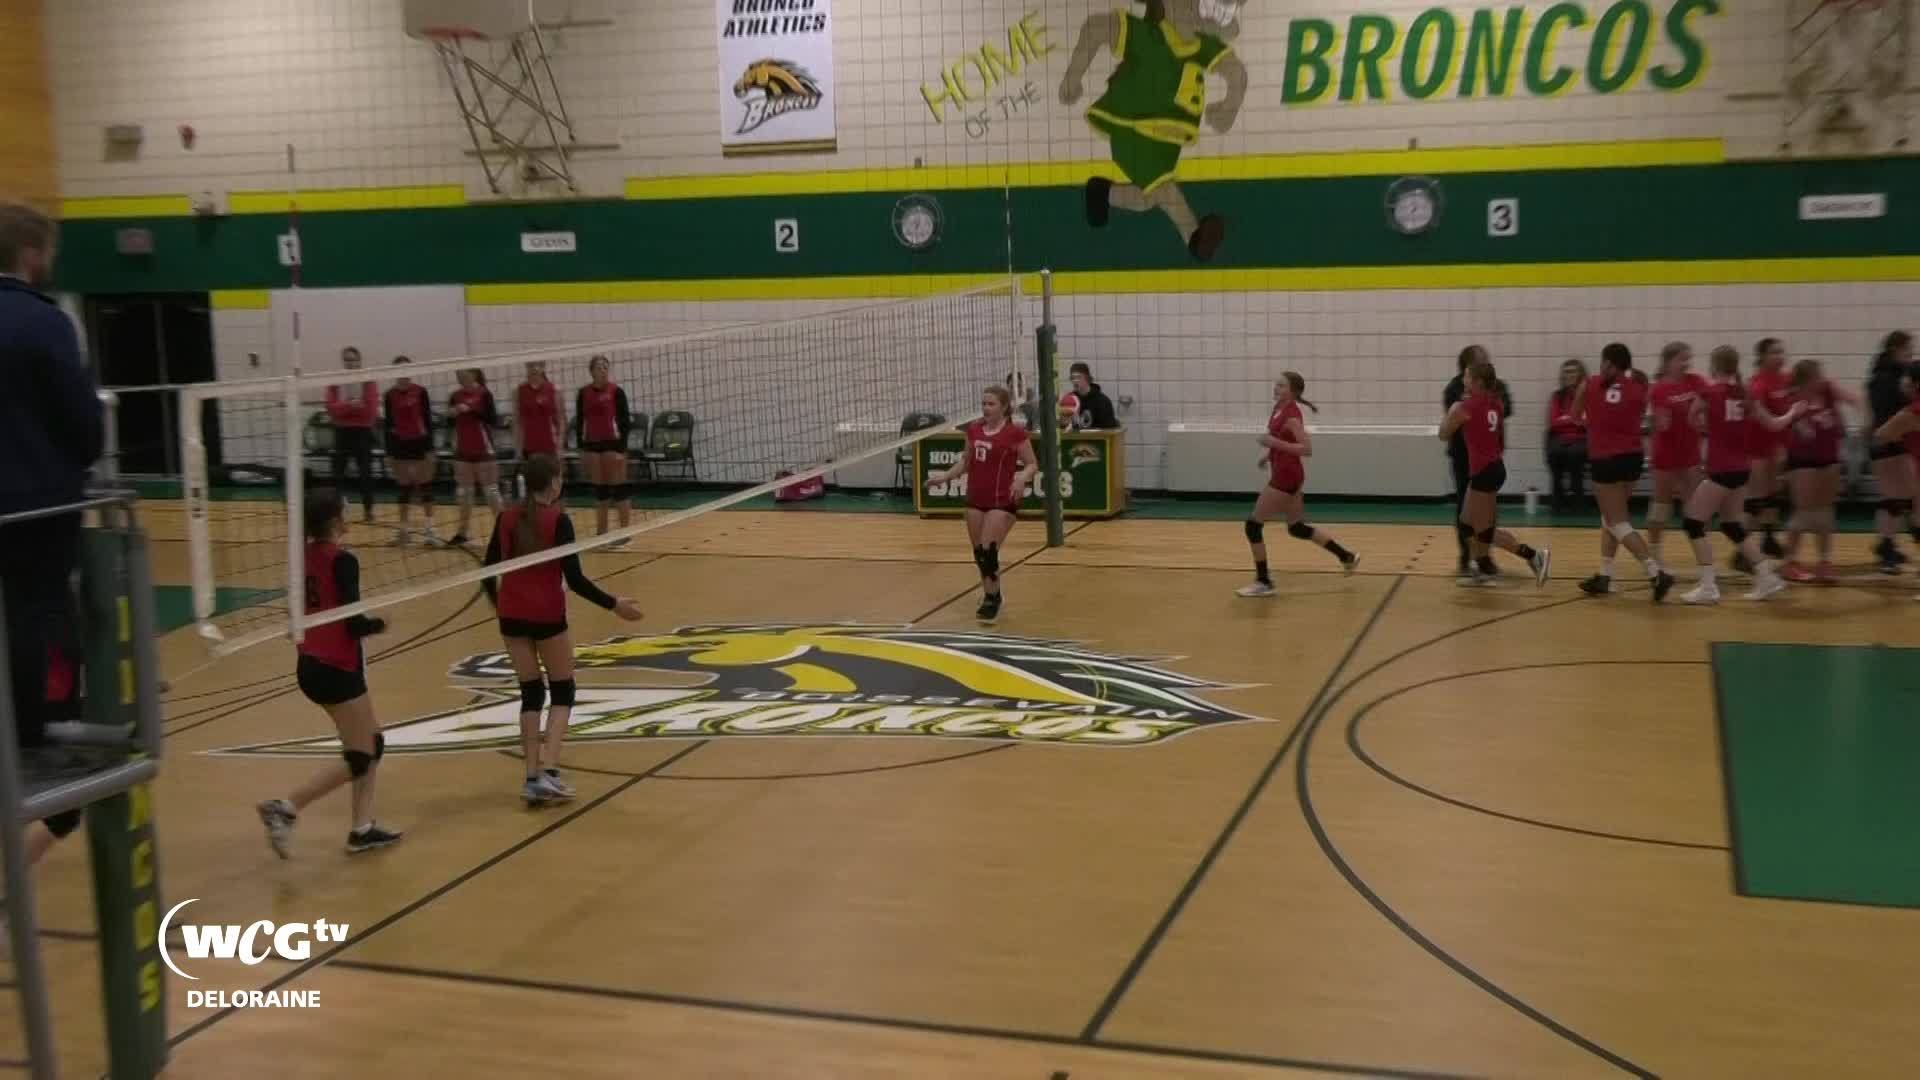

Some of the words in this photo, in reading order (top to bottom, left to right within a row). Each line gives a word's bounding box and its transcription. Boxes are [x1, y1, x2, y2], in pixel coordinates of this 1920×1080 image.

[723, 15, 826, 37] ATHLETICS
[1280, 0, 1723, 104] BRONCOS
[920, 10, 1056, 124] HOME
[964, 107, 990, 138] OF
[997, 81, 1041, 120] THE
[1494, 204, 1512, 232] 3
[778, 223, 795, 248] 2
[1606, 384, 1621, 403] 6
[1487, 410, 1498, 432] 9
[929, 451, 963, 464] HOM
[974, 446, 987, 462] 13
